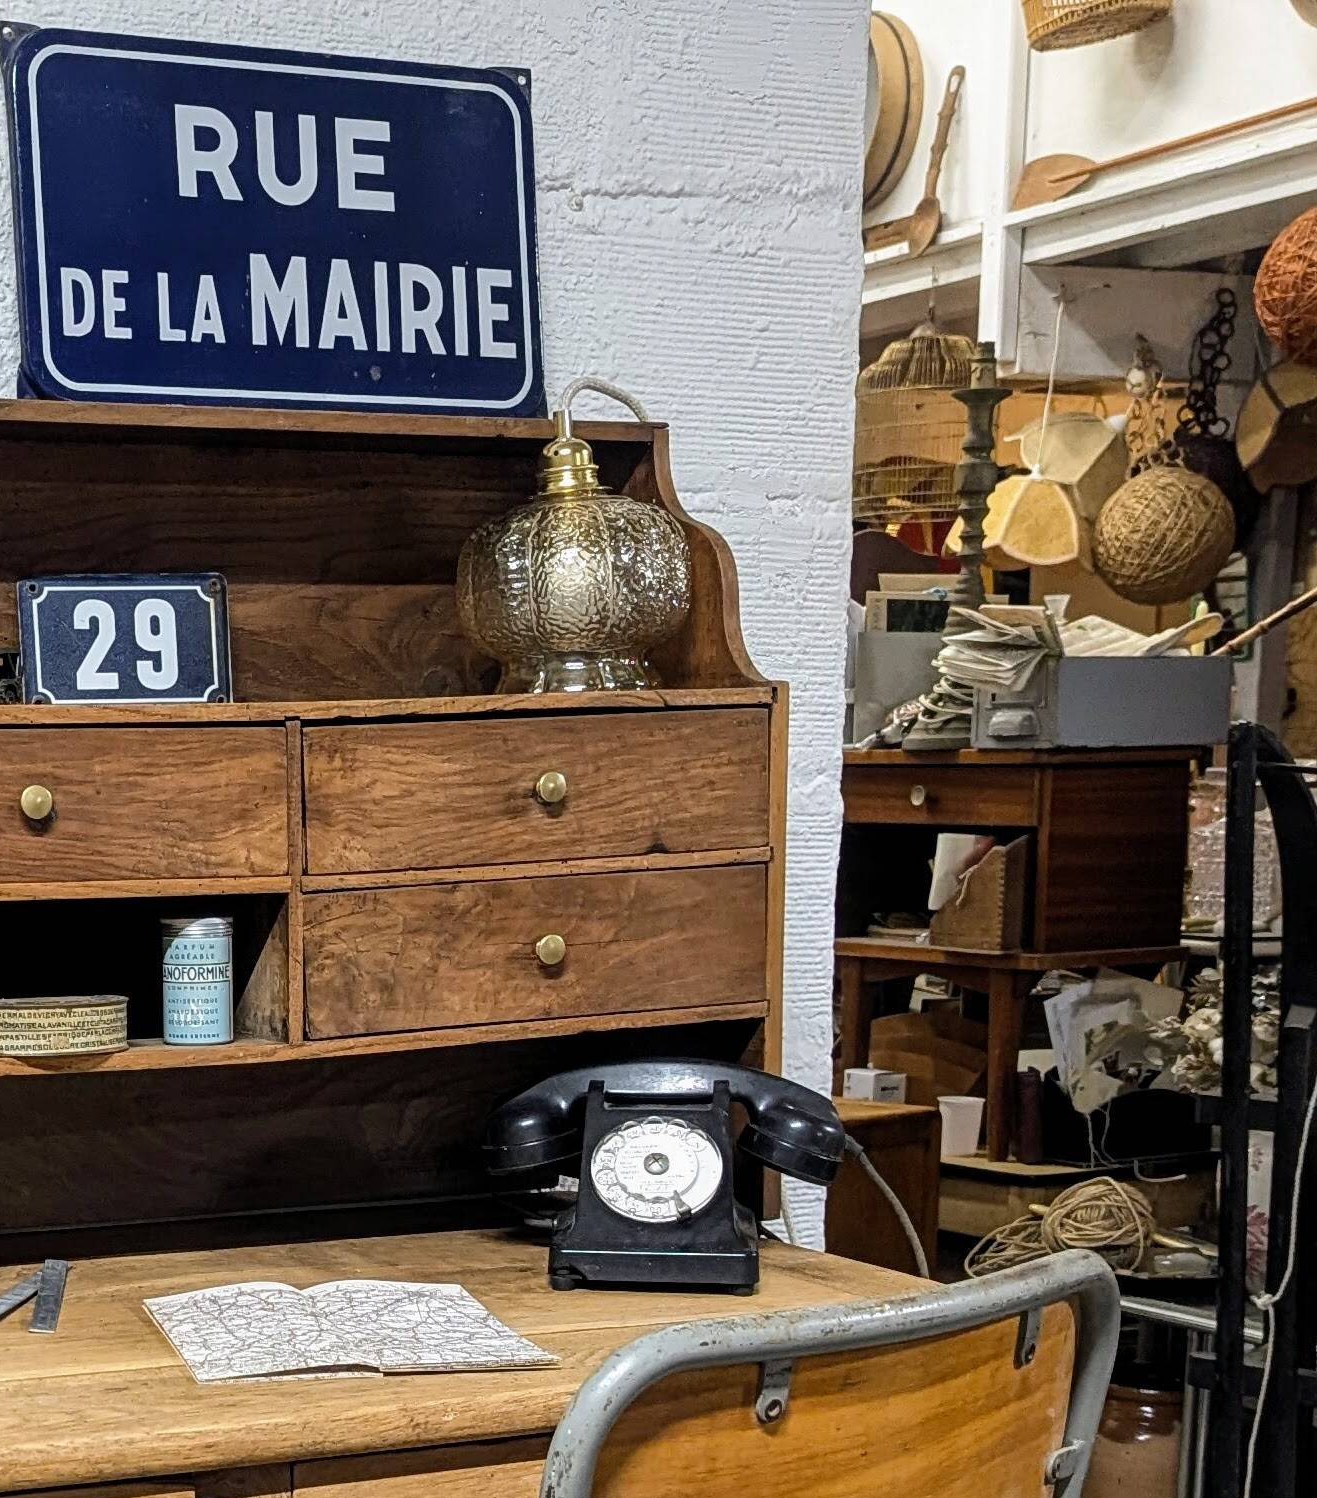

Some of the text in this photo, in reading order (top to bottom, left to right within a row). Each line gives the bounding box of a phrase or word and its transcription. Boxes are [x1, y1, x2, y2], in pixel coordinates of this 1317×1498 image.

[174, 103, 395, 213] RUE
[60, 253, 518, 359] DE LA MAIRIE
[73, 598, 179, 690] 29
[169, 952, 215, 960] AGRÉABLE
